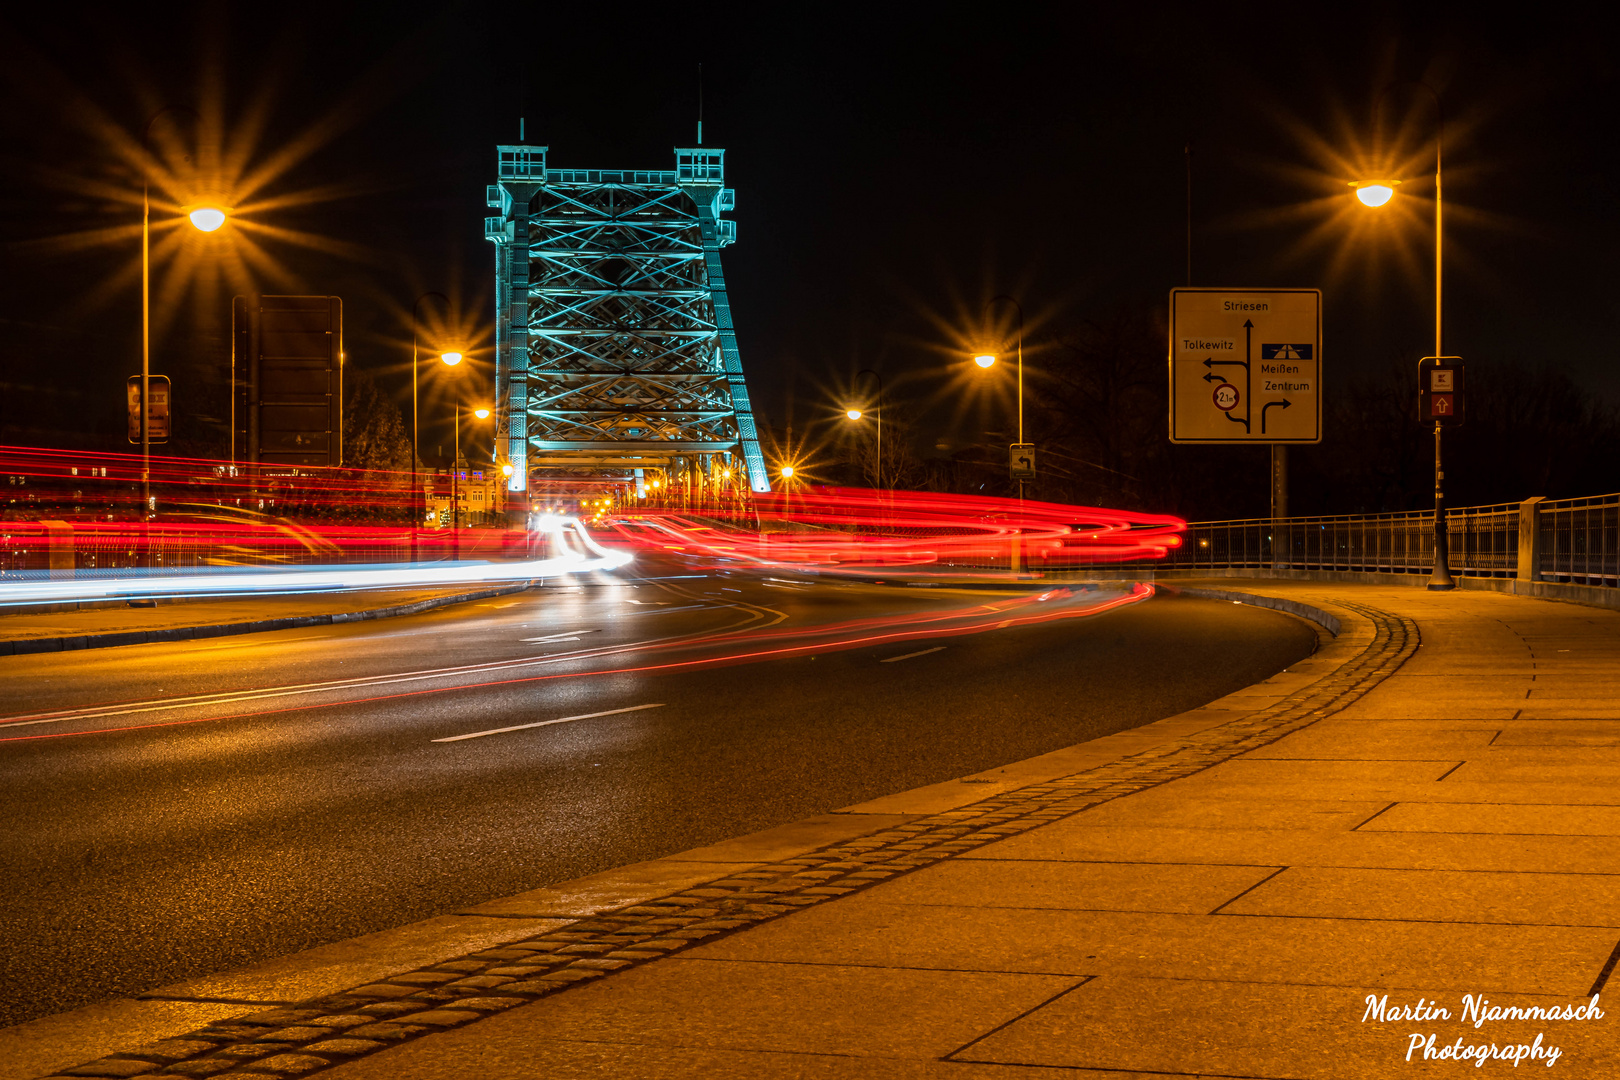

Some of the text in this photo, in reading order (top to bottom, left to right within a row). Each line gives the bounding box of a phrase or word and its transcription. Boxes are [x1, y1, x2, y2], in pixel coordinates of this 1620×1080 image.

[1223, 301, 1268, 311] Striesen
[1183, 340, 1234, 350] Tolkewitz
[1261, 363, 1299, 374] Meißen
[1264, 381, 1310, 391] Zentrum
